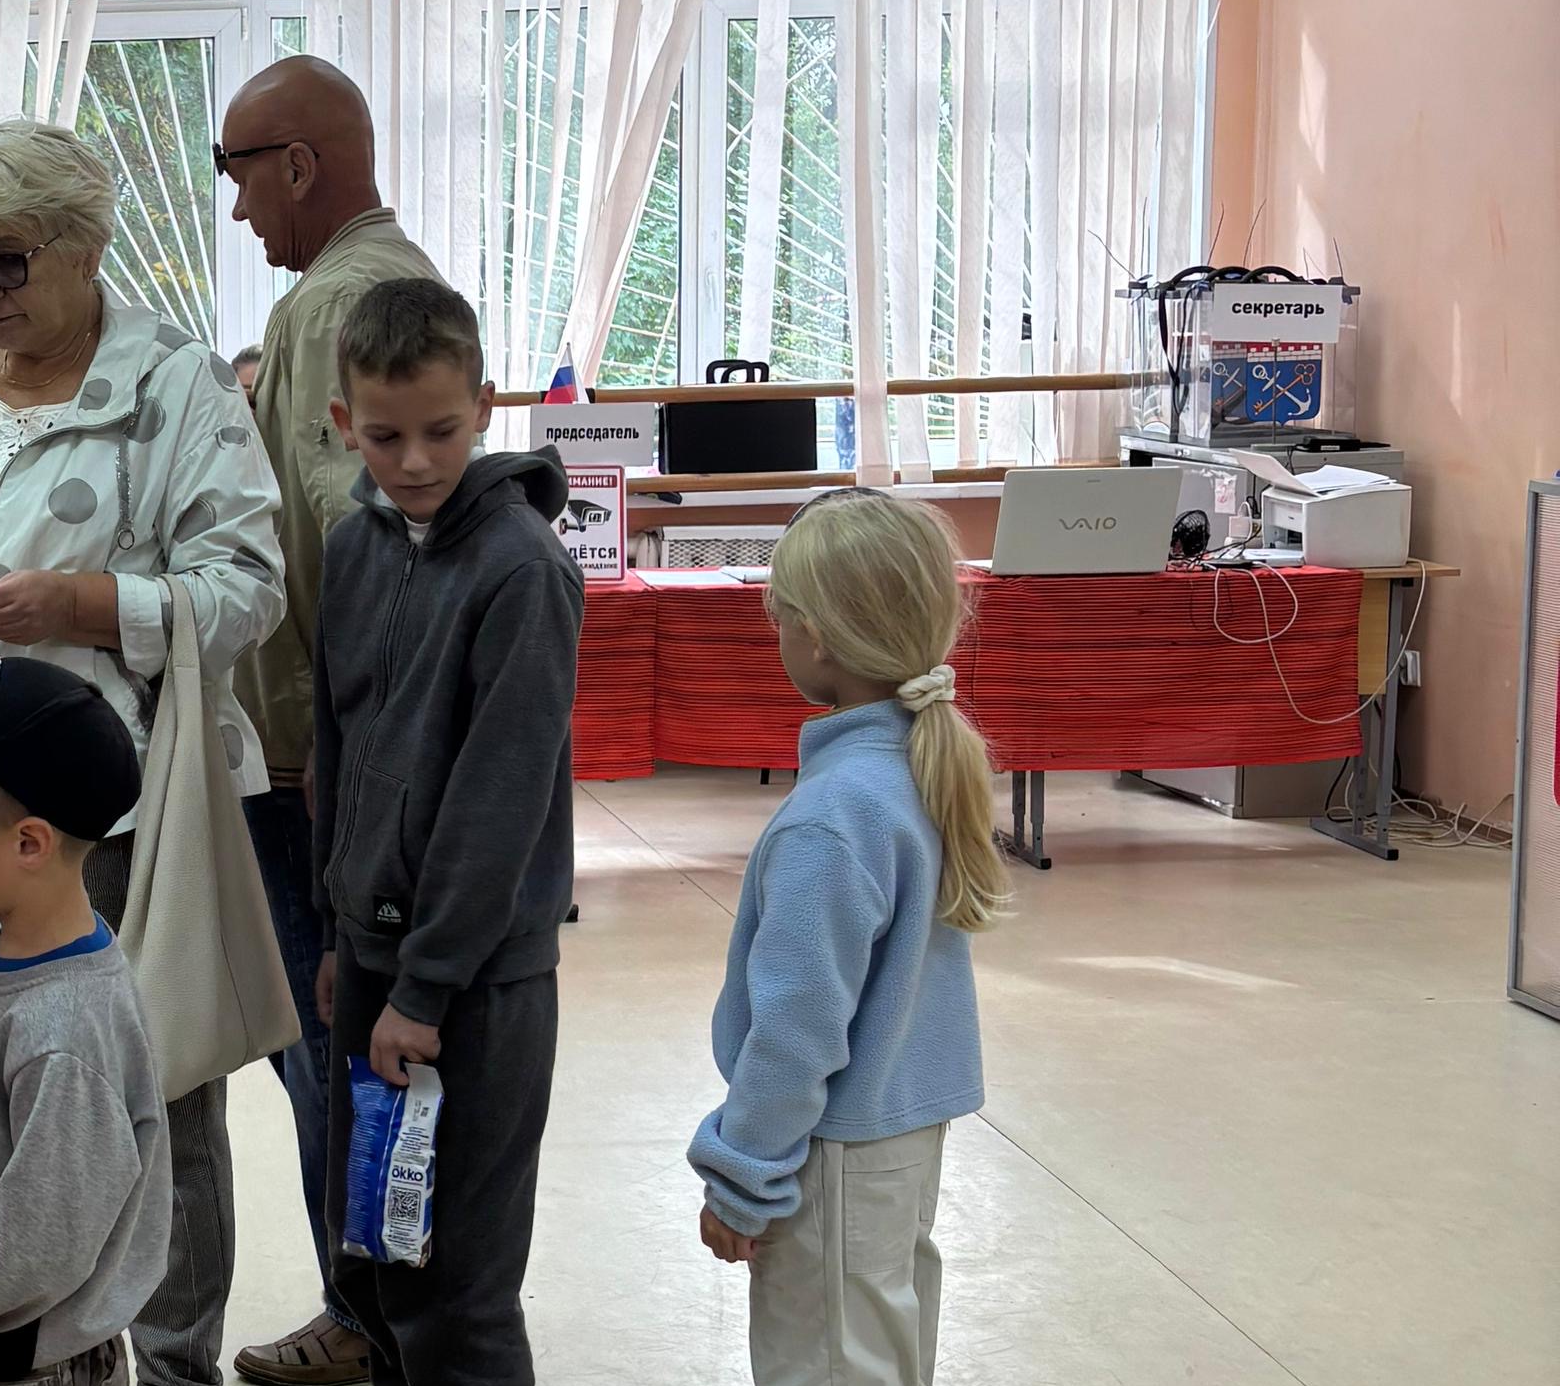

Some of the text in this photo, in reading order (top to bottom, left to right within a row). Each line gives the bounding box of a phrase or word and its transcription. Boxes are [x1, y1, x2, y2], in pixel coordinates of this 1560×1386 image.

[1232, 301, 1325, 318] секретарь
[546, 426, 640, 443] председатель
[1059, 517, 1117, 531] VAIO
[569, 544, 617, 561] ДЁТСЯ
